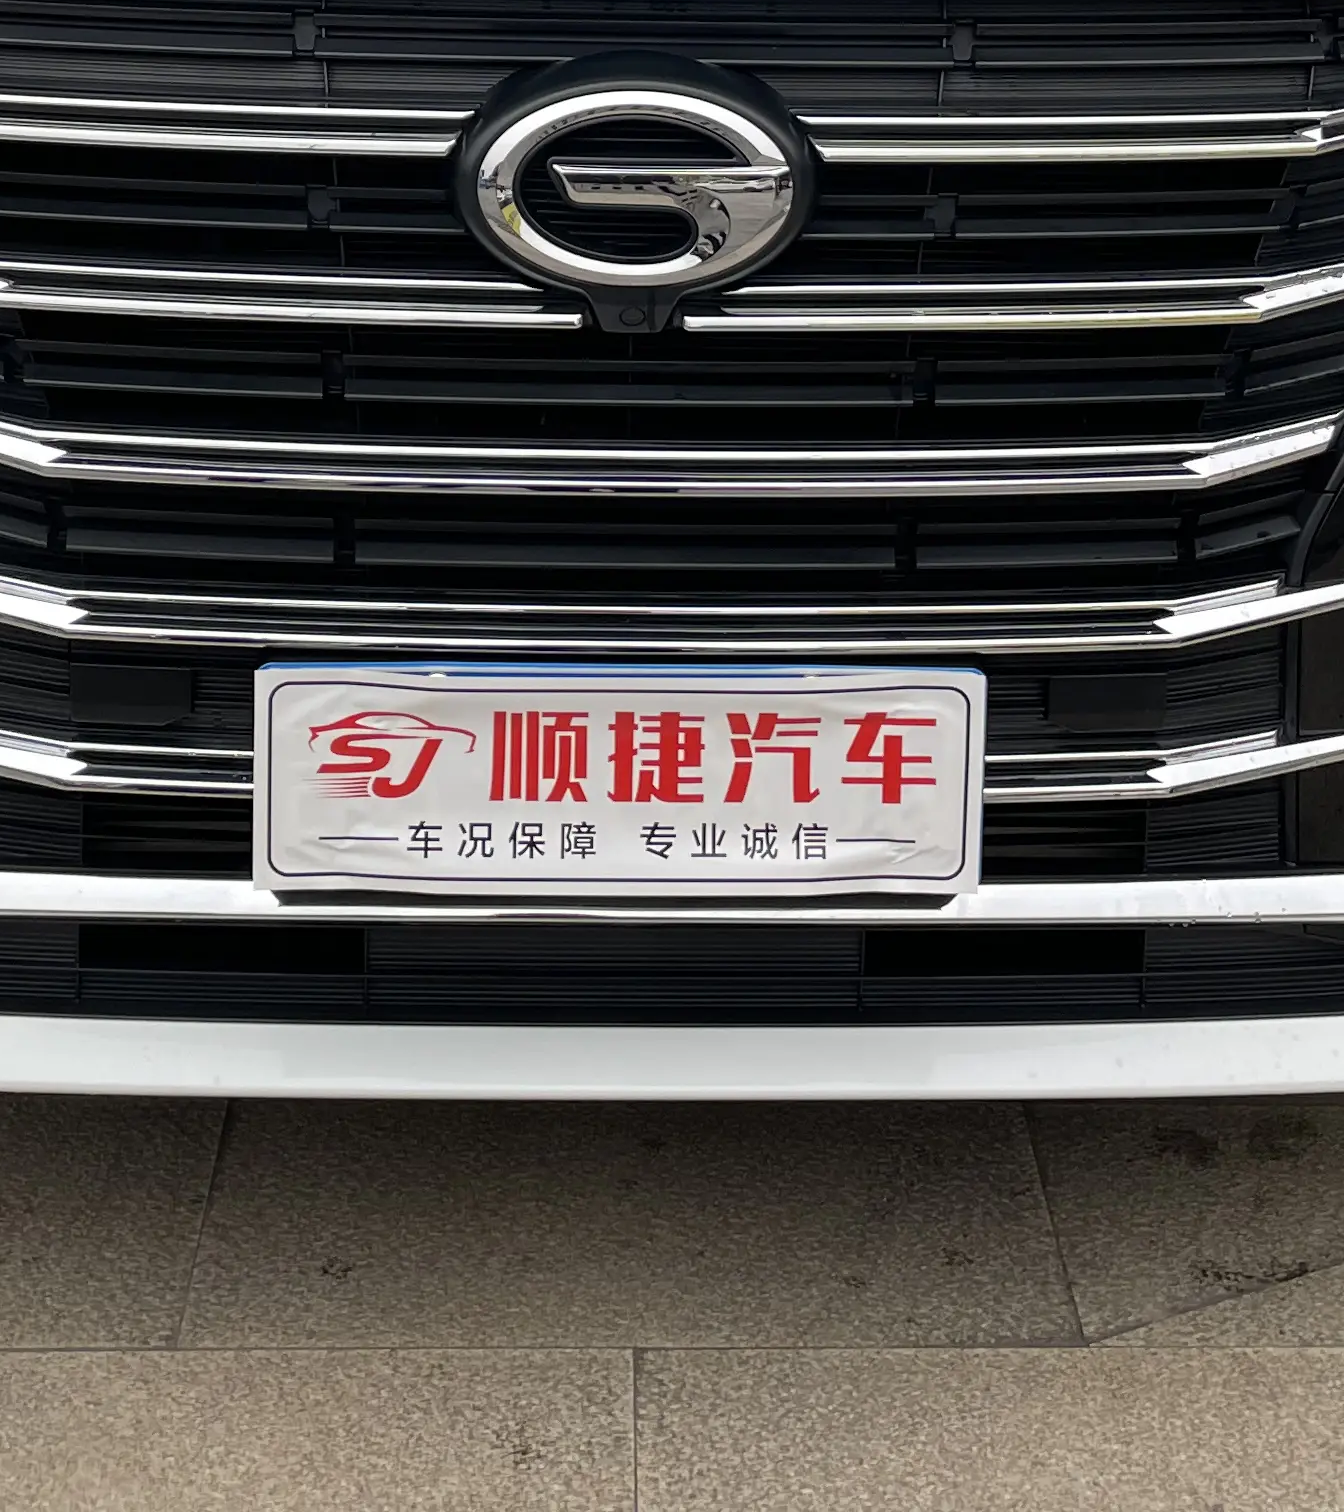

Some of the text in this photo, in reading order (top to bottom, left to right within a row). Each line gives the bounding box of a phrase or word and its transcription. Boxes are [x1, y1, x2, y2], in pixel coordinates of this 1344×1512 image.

[489, 710, 937, 805] 顺捷汽车
[407, 821, 829, 861] 车况保障 专业诚信
